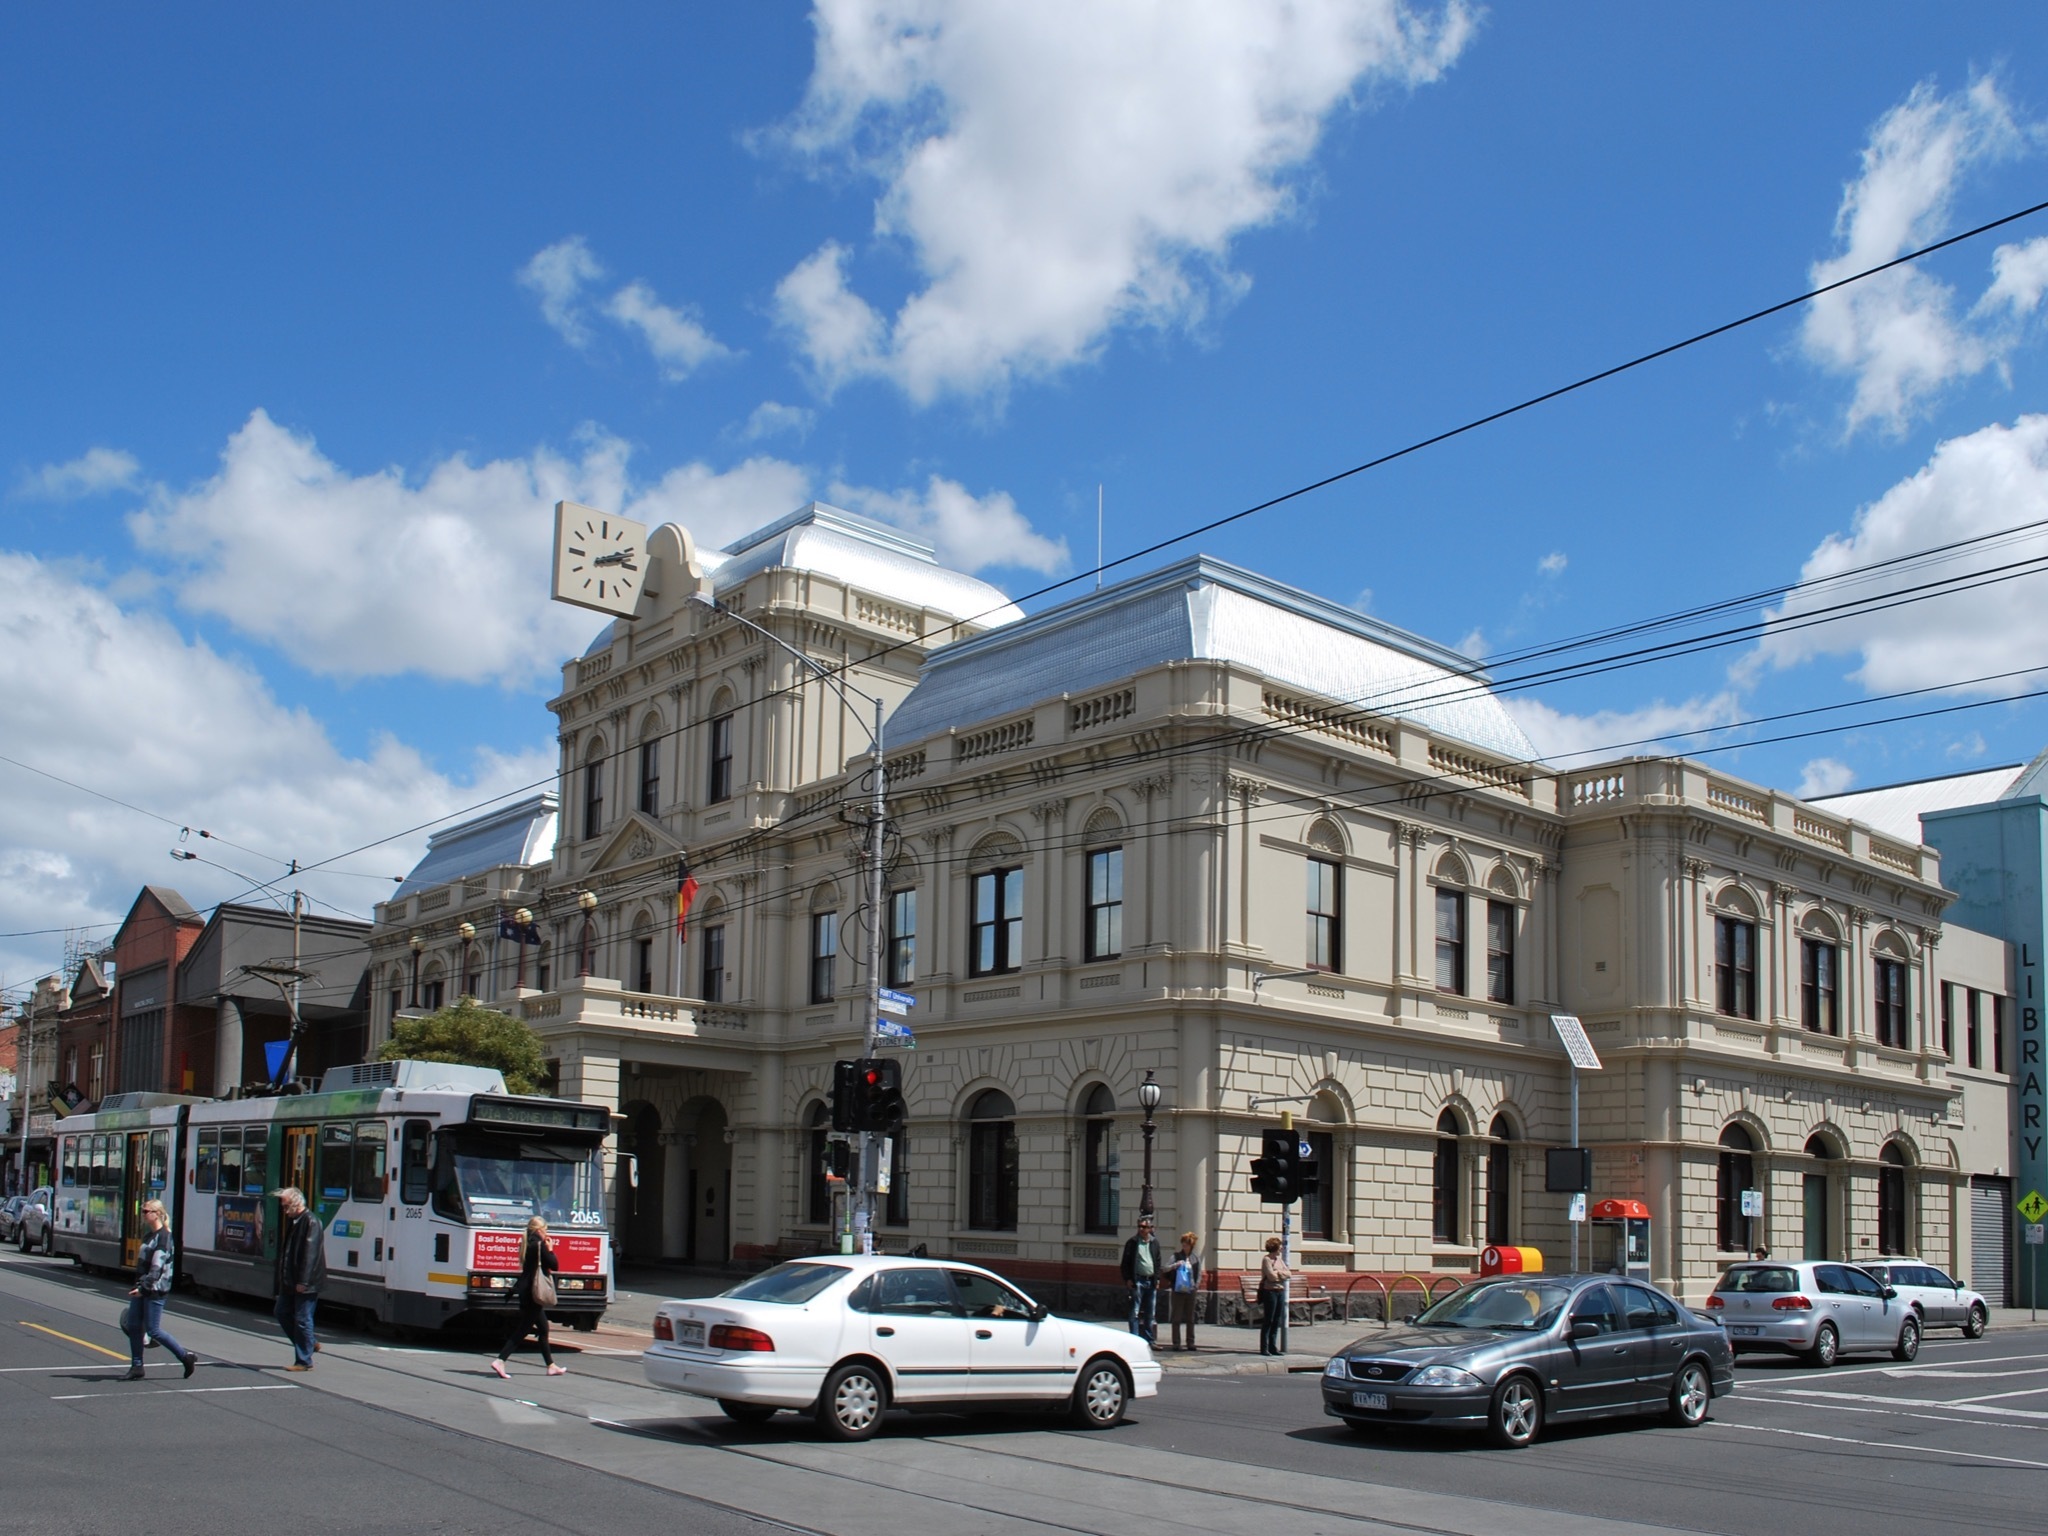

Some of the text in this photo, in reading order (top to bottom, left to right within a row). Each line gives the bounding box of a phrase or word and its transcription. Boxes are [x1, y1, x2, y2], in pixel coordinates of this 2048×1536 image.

[892, 991, 914, 1005] University
[878, 1038, 901, 1046] SYDNEY
[2022, 943, 2042, 1161] LIBRARY
[1759, 1073, 1897, 1102] MUNICIPAL CHAMBERS
[480, 1108, 501, 1120] VIA
[507, 1108, 545, 1123] SYDNEY
[405, 1208, 423, 1219] 2065
[571, 1211, 600, 1224] 2065
[478, 1235, 494, 1243] Basil
[478, 1244, 486, 1252] 15
[1372, 1394, 1387, 1406] 792
